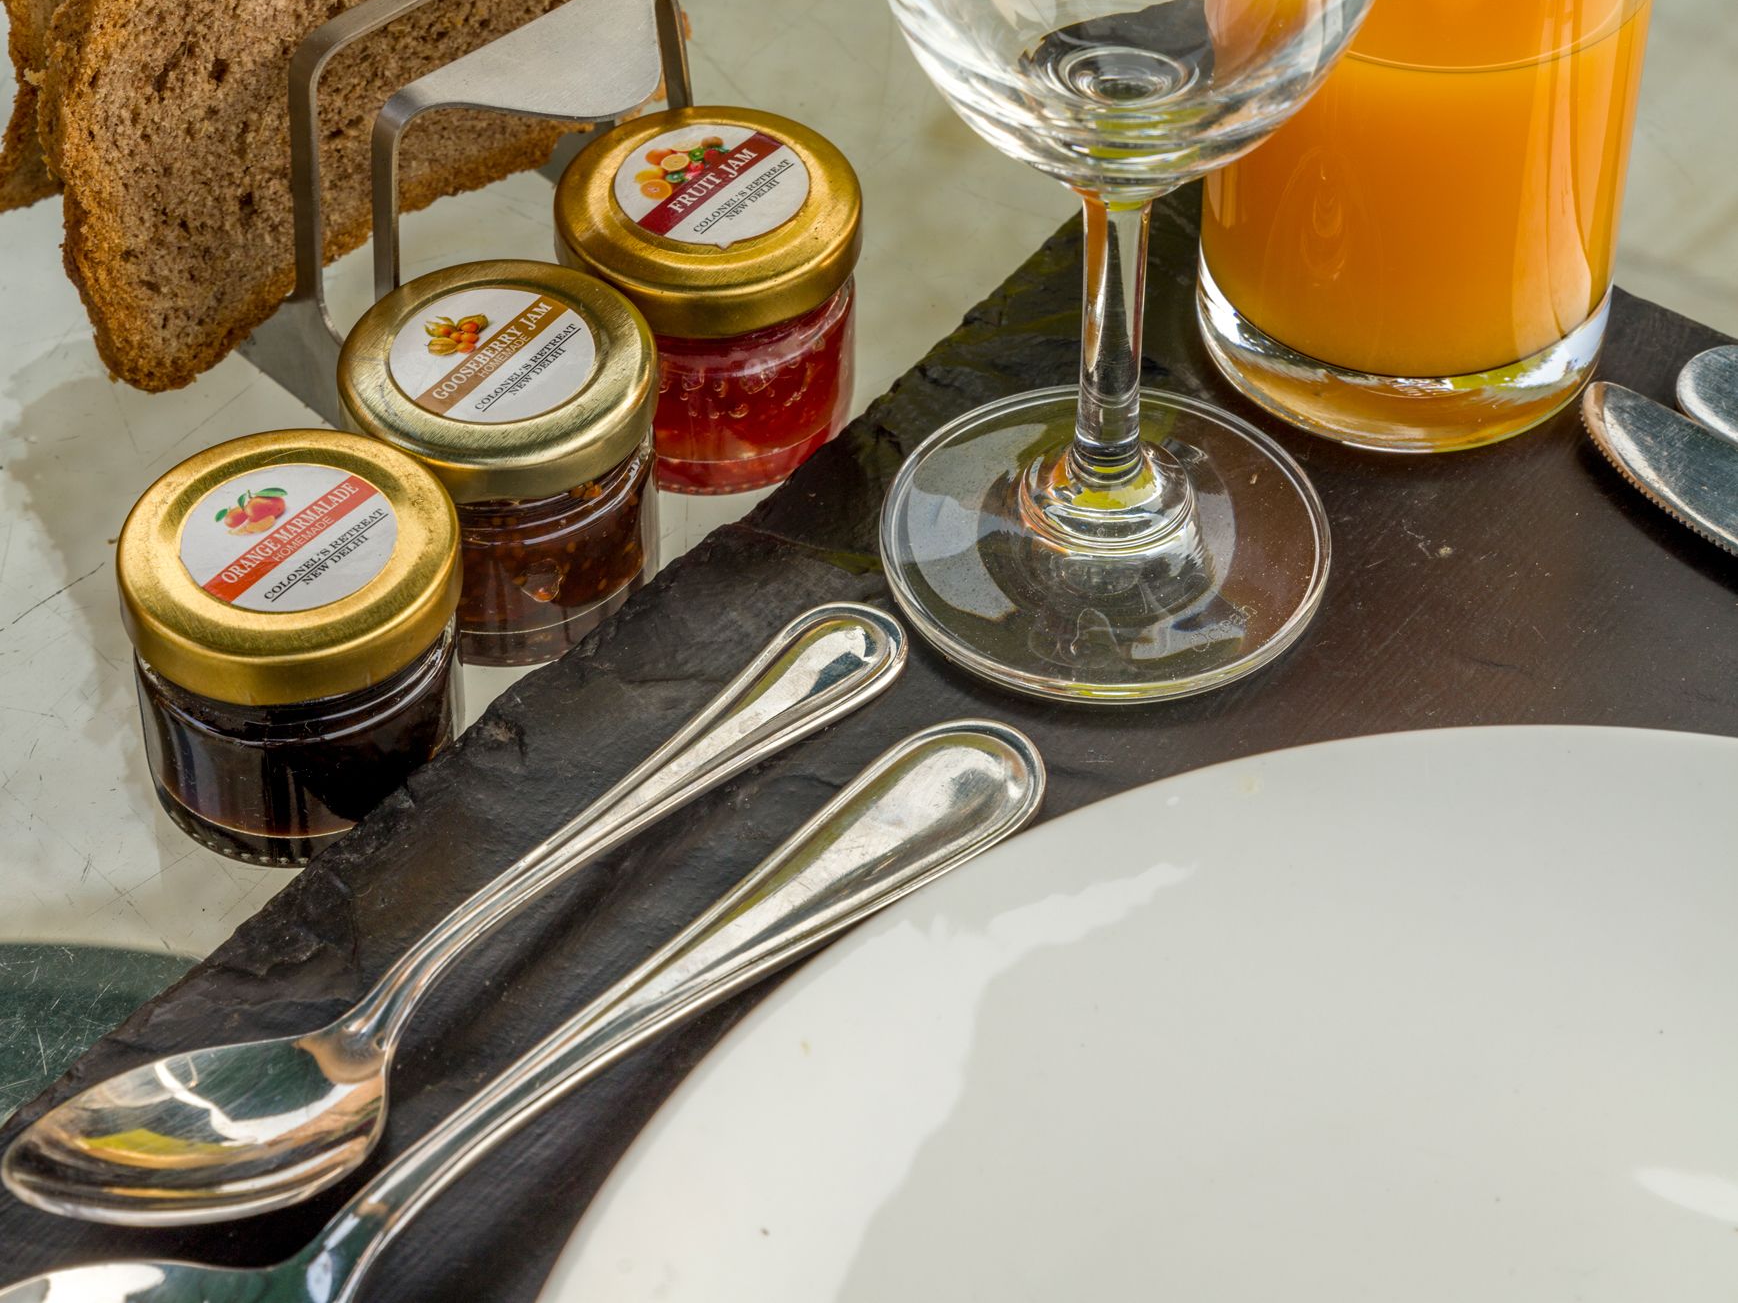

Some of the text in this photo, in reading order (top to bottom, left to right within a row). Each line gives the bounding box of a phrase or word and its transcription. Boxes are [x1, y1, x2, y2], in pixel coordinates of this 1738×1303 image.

[668, 148, 758, 214] FRUIT JAM
[693, 159, 791, 233] COLONEL'S RETREAT
[725, 179, 780, 221] NEW DELHI
[432, 302, 552, 400] GOOSEBERRY JAM
[474, 323, 578, 411] COLONEL'S RETREAT
[478, 335, 531, 378] HOMEMADE
[508, 348, 566, 396] NEW DELHI
[221, 482, 359, 584] ORANGE MARMALADE
[264, 508, 384, 601] COLONEL'S RETREAT
[272, 516, 334, 563] HOMEMADE
[302, 535, 369, 585] NEW DELHI
